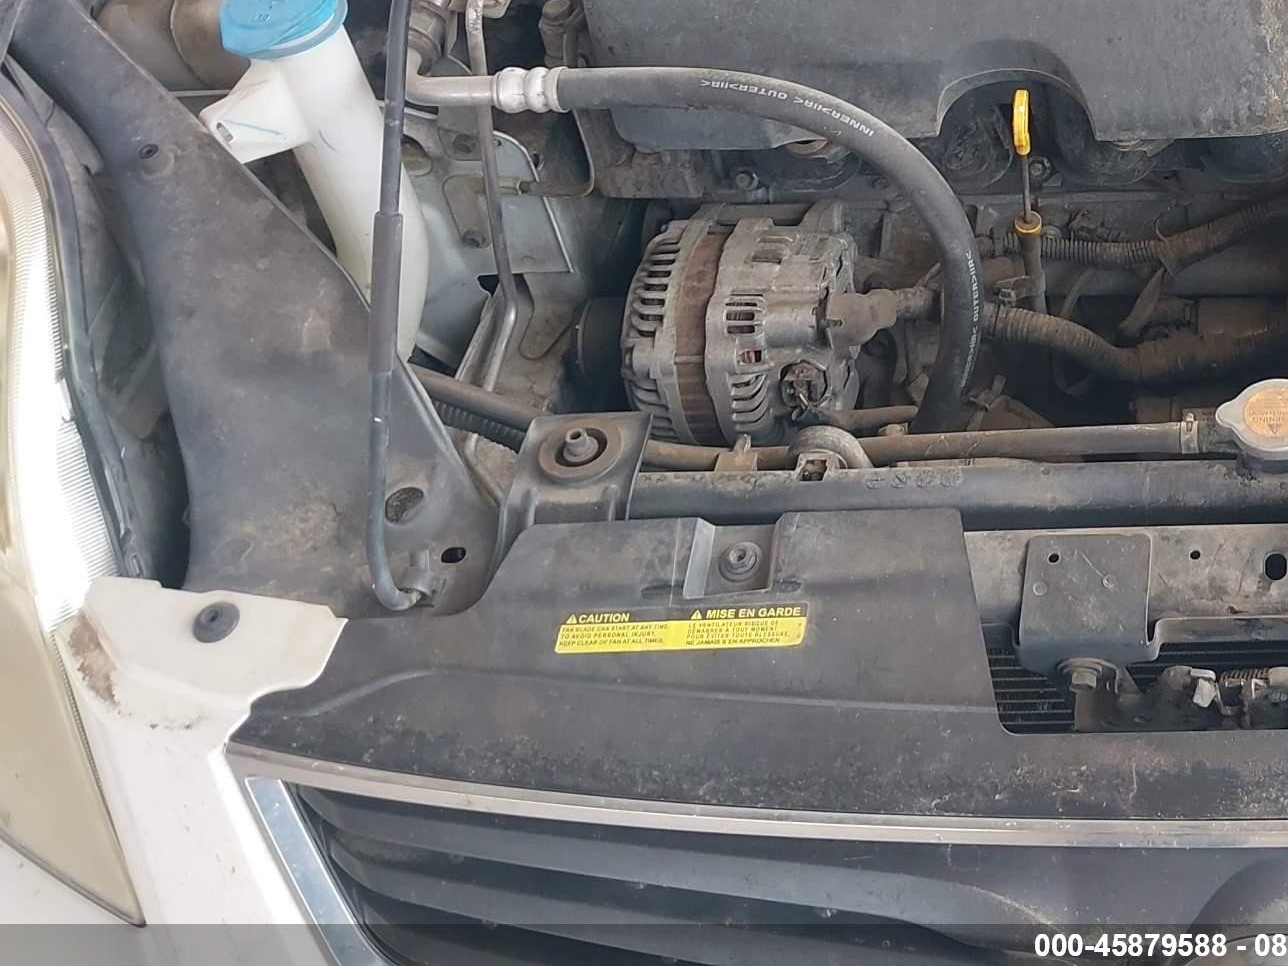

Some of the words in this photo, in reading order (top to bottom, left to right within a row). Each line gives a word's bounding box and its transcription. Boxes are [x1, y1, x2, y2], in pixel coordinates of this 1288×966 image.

[578, 613, 630, 623] CAUTION
[706, 608, 736, 619] MISE
[738, 608, 756, 618] EN
[758, 607, 801, 617] GARDE
